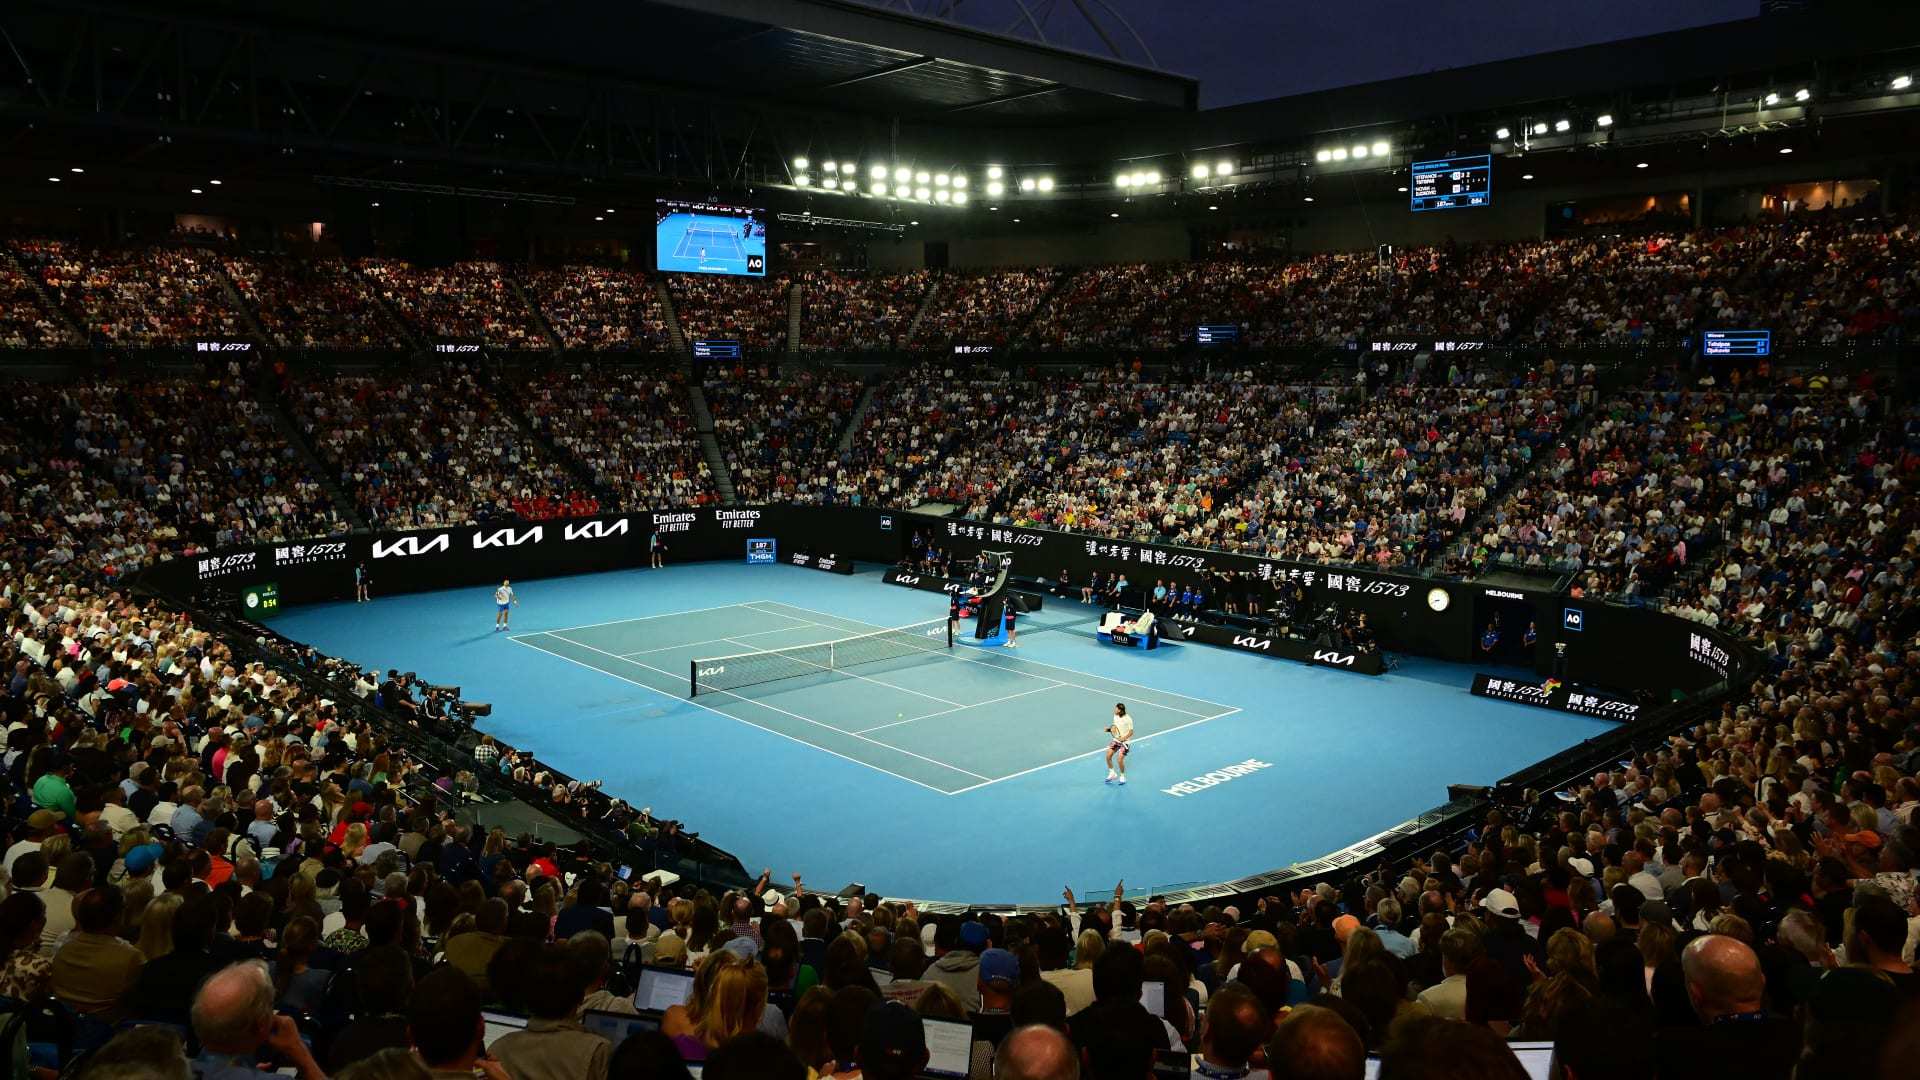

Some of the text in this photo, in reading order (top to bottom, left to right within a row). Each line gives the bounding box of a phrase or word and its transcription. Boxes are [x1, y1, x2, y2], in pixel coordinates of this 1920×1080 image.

[748, 258, 762, 268] AO
[653, 512, 697, 525] Emirates
[715, 509, 761, 520] Emirates
[564, 519, 629, 540] KIA
[659, 522, 690, 533] FLY BETTER
[722, 519, 754, 529] FLY BETTER
[473, 526, 543, 549] KIA
[372, 533, 450, 558] KIA
[1485, 589, 1524, 600] MELBOURNE
[1566, 613, 1580, 624] AO
[1233, 634, 1271, 650] KIA
[1313, 649, 1355, 666] KIA
[698, 665, 725, 677] KIA
[1159, 758, 1275, 797] MELBOURNE
